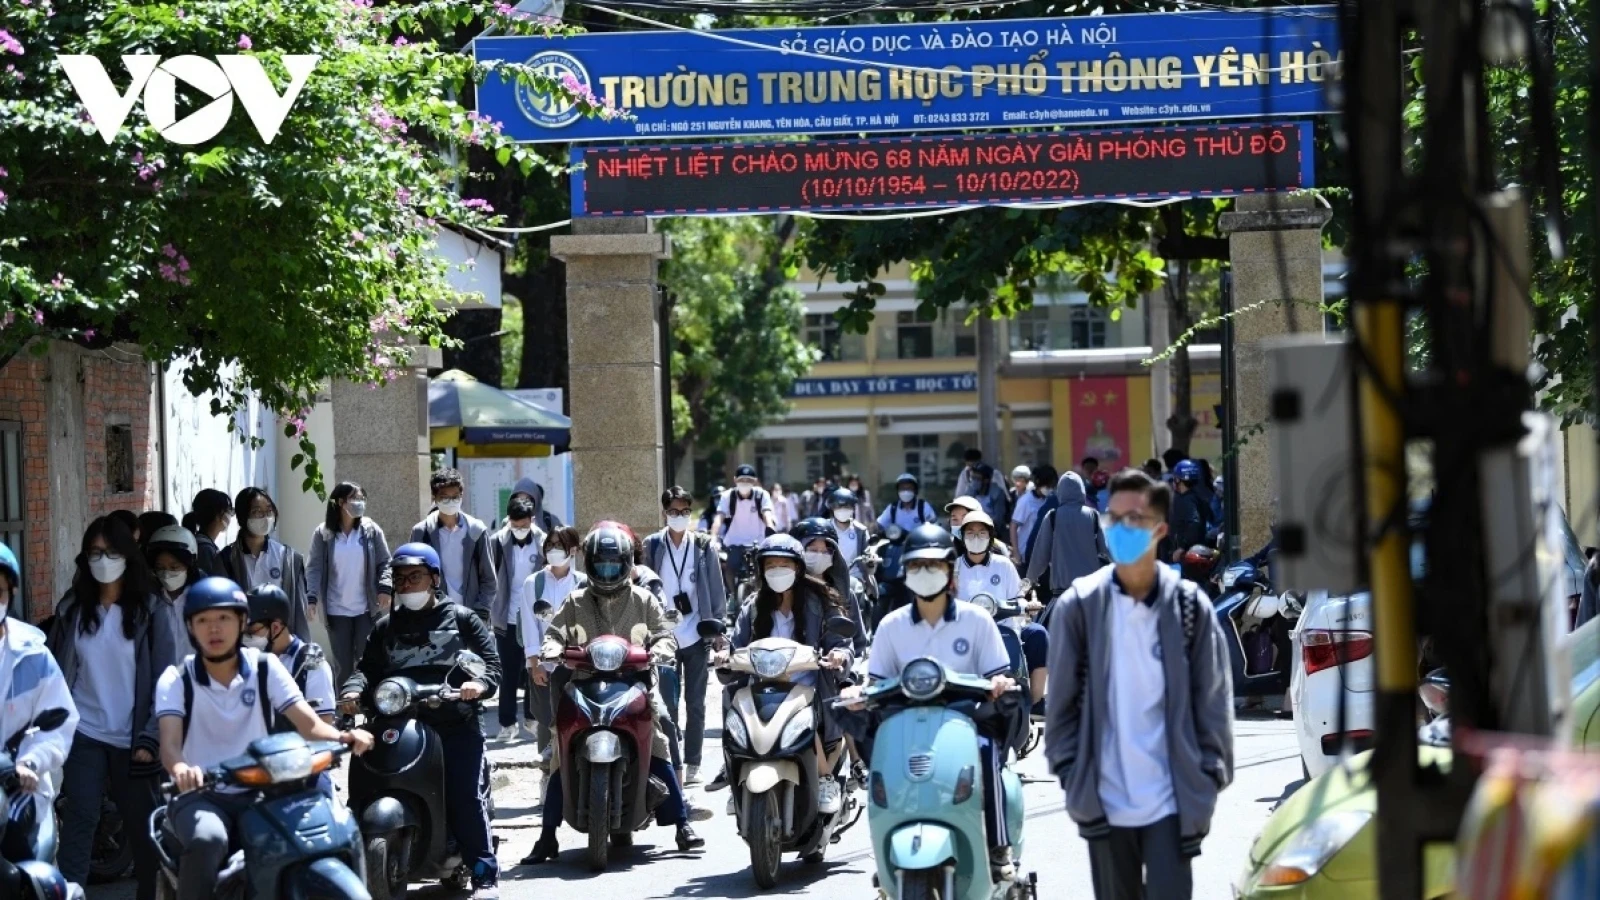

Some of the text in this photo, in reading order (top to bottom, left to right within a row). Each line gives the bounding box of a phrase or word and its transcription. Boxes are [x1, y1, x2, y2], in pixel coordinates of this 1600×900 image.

[780, 22, 1117, 57] SỞ GIÁO DỤC VÀ ĐÀO TẠO HÀ NỘI
[599, 65, 748, 109] TRƯỜNG
[757, 68, 882, 105] TRUNG
[889, 64, 963, 106] HỌC
[971, 49, 1048, 97] PHỔ
[1056, 51, 1182, 94] THÔNG
[1193, 46, 1269, 88] YÊN
[928, 113, 950, 124] 0243
[951, 113, 967, 123] 833
[969, 112, 990, 122] 3721
[1003, 110, 1028, 121] Email:
[1121, 104, 1211, 117] Website: c3yh.edu.vn
[635, 120, 650, 135] ĐỊA
[690, 120, 706, 131] 251
[707, 116, 742, 131] NGUYỄN
[743, 118, 774, 130] KHANG,
[776, 116, 792, 128] YÊN
[814, 115, 832, 128] CẦU
[855, 115, 868, 127] TP.
[869, 113, 882, 126] HÀ
[884, 112, 899, 128] NỘI
[598, 130, 1286, 180] NHIỆT LIỆT CHÀO MỪNG 68 NĂM NGÀY GIẢI PHÓNG THỦ ĐÔ
[801, 174, 927, 203] (10/10/1954
[955, 168, 1080, 193] 10/10/2022)
[915, 376, 948, 393] HỌC
